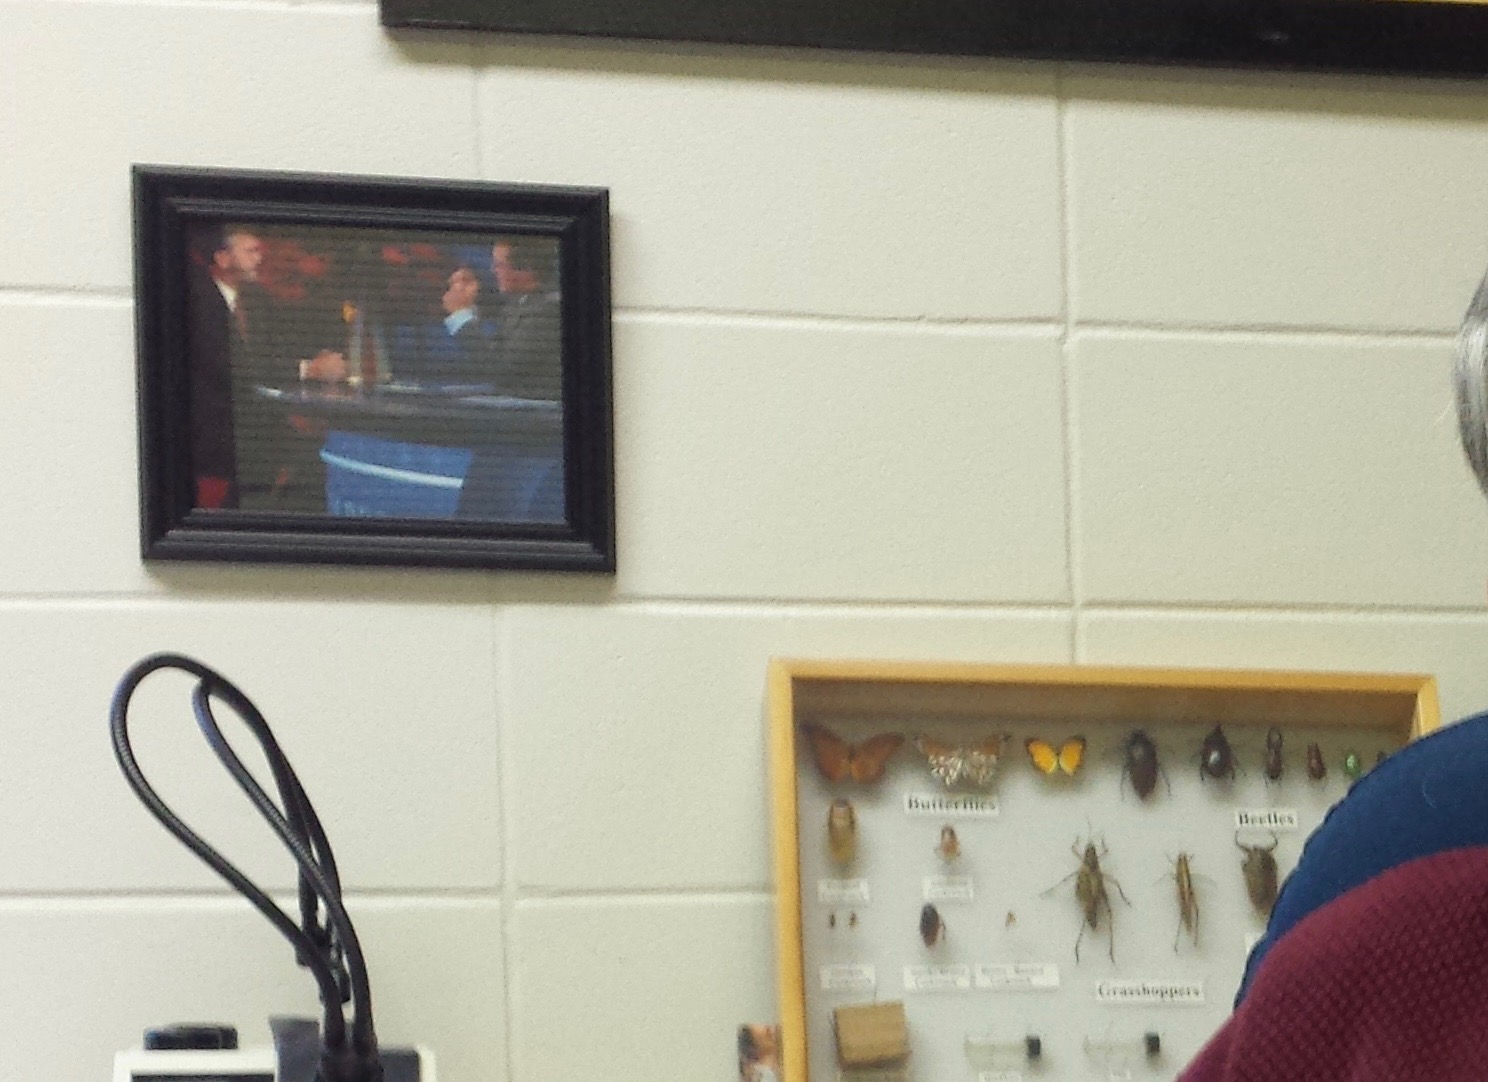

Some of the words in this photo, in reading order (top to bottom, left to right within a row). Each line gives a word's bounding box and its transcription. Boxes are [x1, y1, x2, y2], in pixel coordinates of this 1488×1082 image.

[908, 796, 996, 810] Butterflies
[1239, 812, 1294, 824] Beetles
[1098, 984, 1199, 998] Grasshoppers
